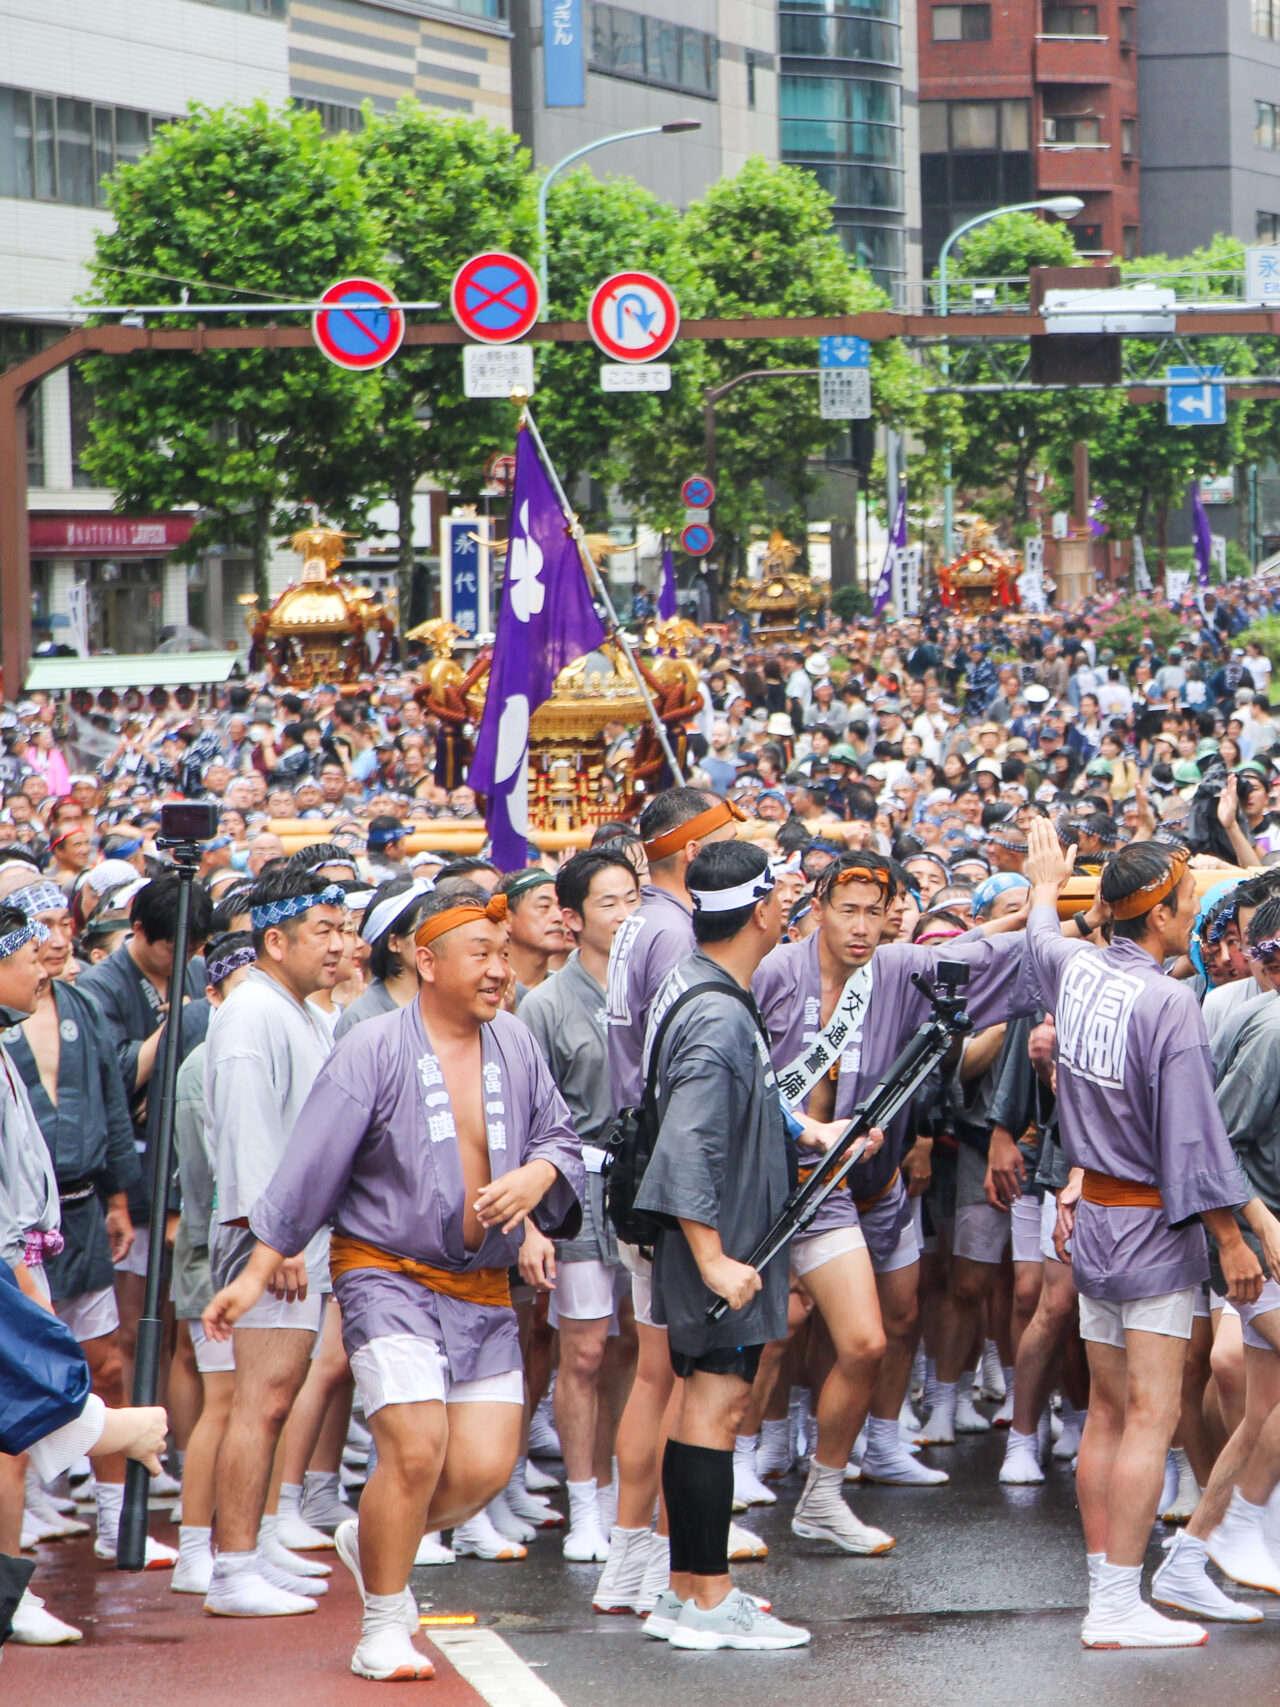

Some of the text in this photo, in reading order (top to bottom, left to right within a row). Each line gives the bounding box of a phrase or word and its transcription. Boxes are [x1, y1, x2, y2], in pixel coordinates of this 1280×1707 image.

[608, 370, 665, 385] ここまで
[454, 531, 477, 633] 永代橋
[778, 989, 865, 1101] 交通警備
